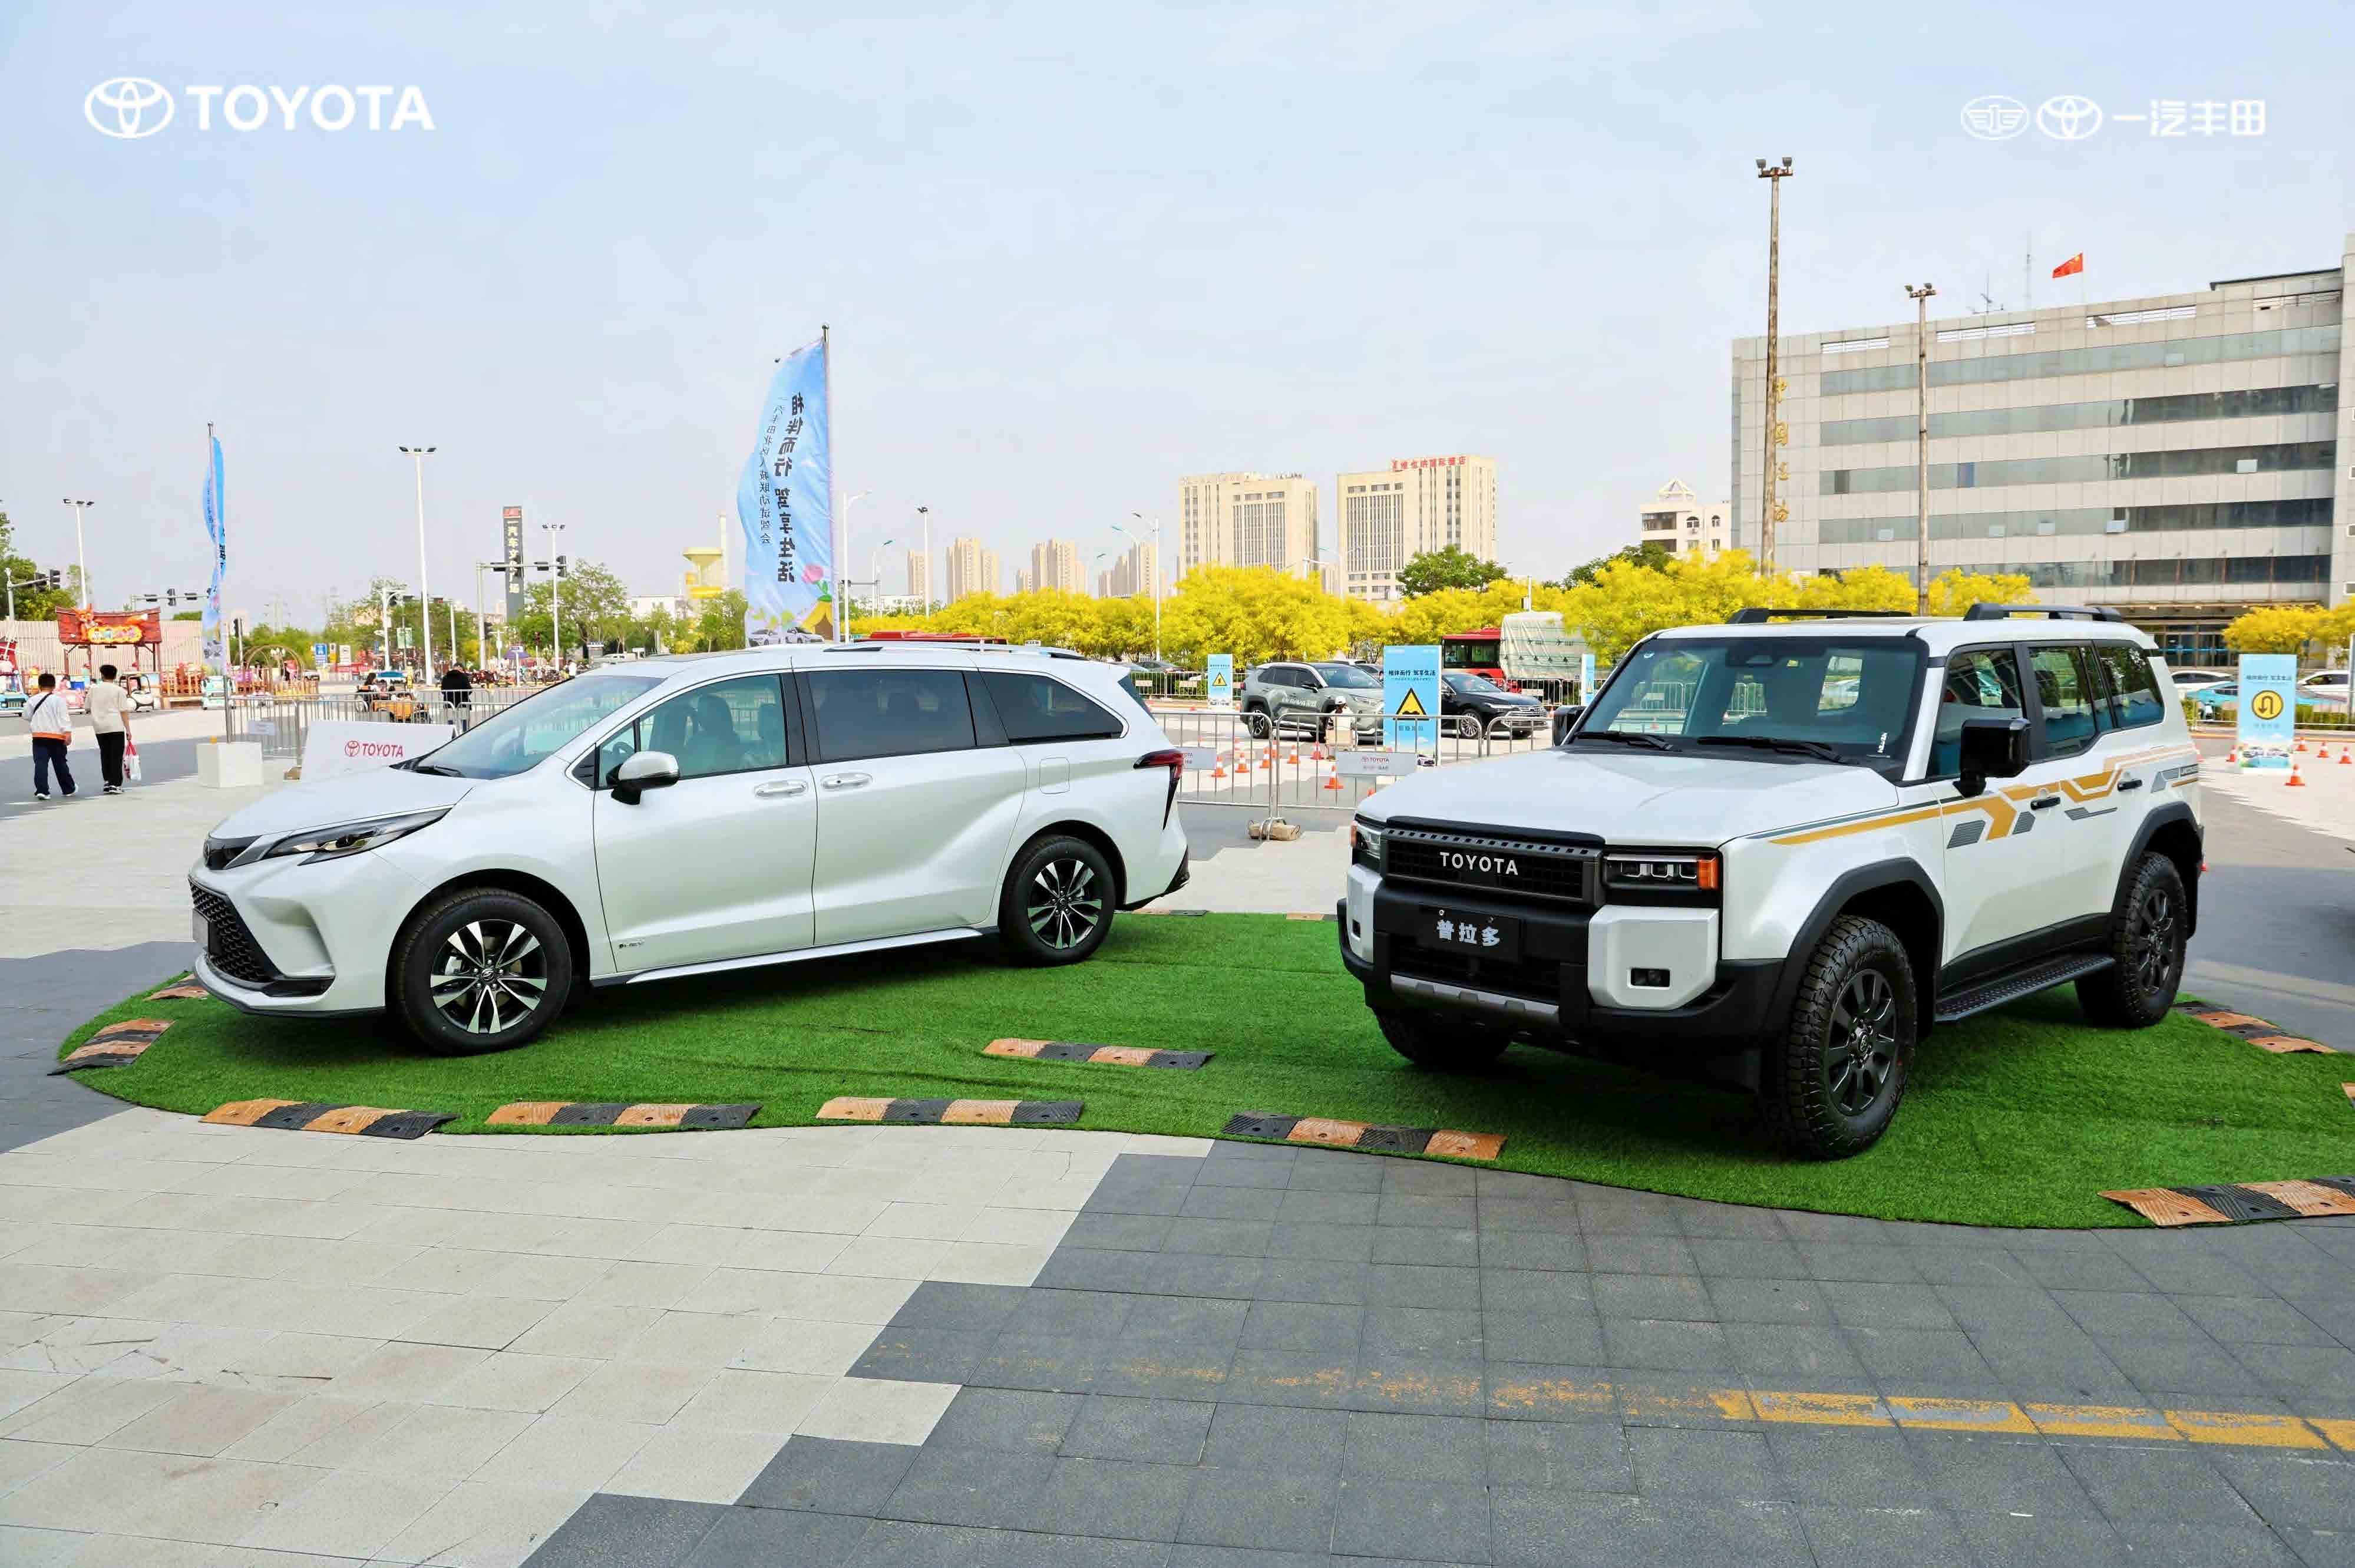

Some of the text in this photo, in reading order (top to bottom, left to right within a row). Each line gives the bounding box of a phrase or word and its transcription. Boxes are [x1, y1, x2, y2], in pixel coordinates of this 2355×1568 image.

[362, 743, 404, 758] TOYOTA
[1439, 851, 1518, 876] TOYOTA
[1436, 919, 1500, 946] 普拉多
